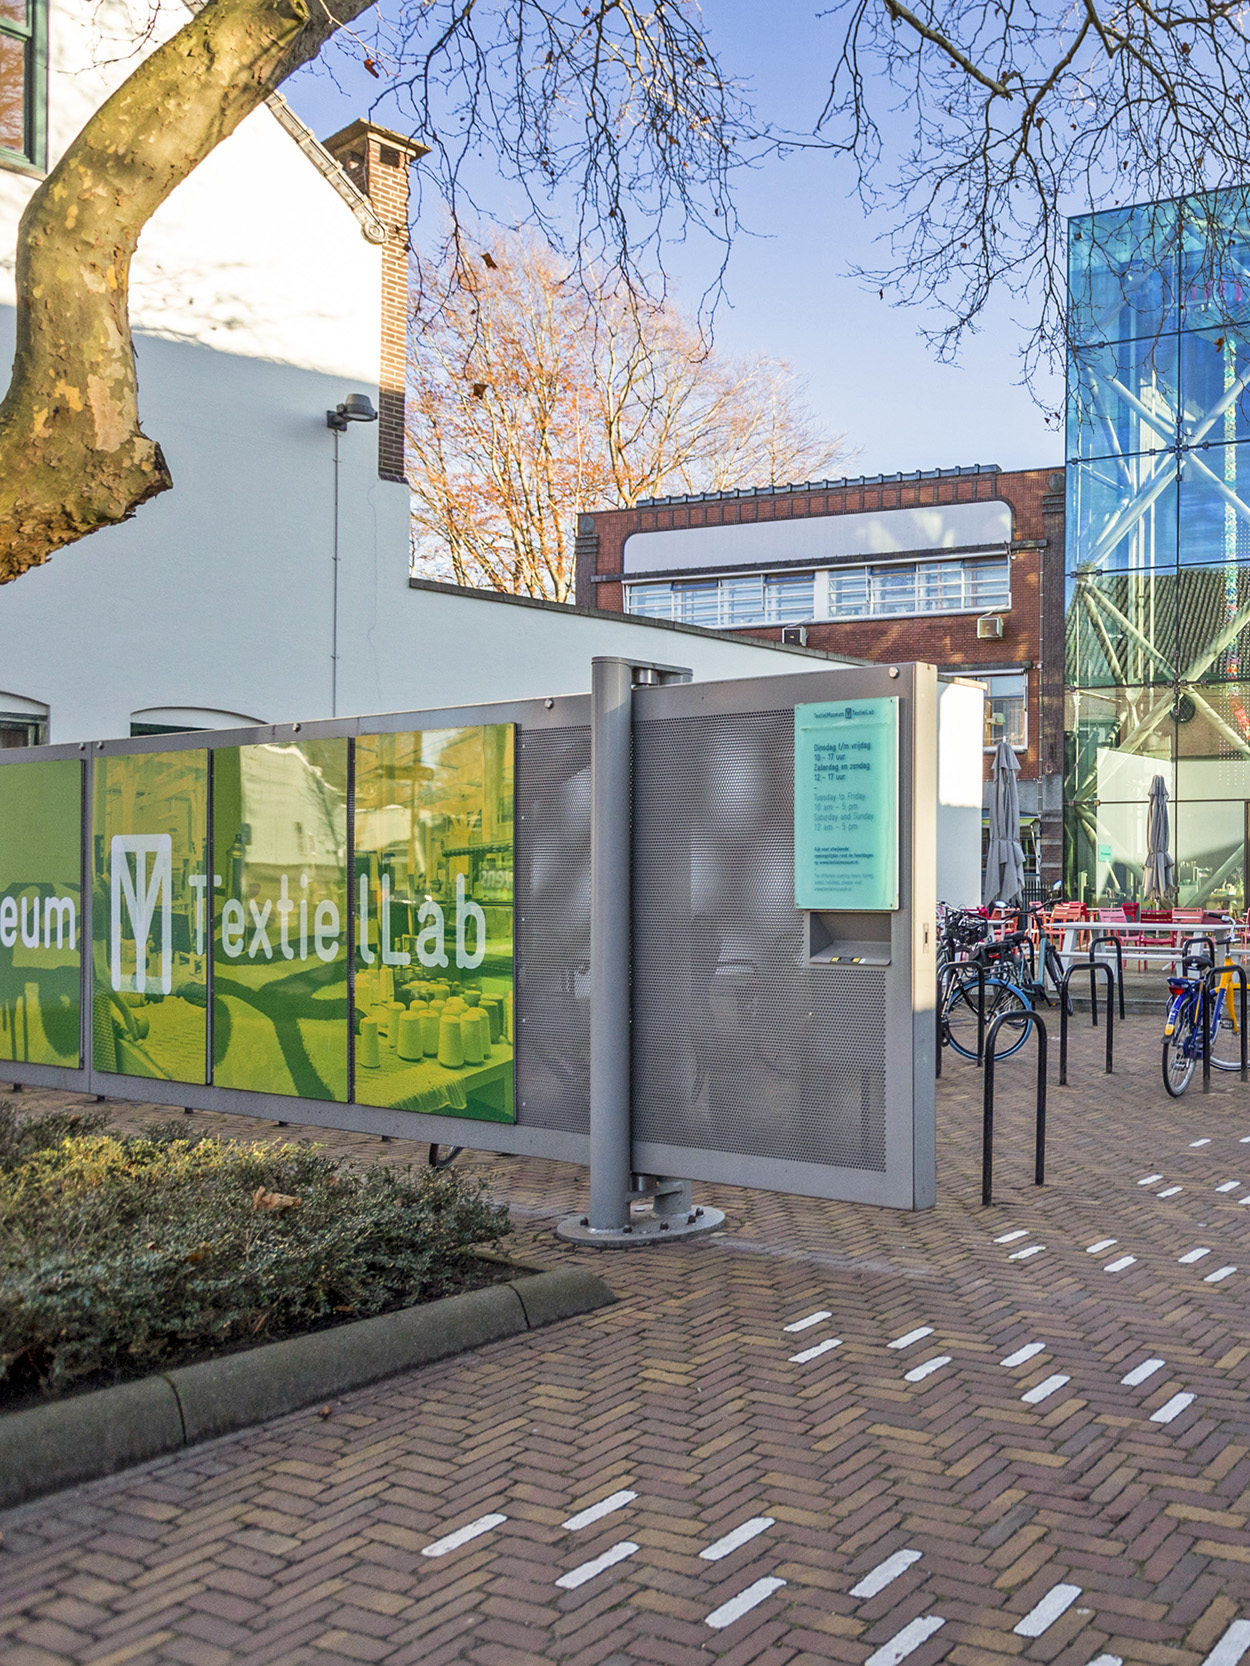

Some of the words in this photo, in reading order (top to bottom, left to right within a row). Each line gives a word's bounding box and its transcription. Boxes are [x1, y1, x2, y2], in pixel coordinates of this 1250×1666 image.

[814, 744, 836, 752] Dinsdag
[838, 742, 849, 750] t/m
[851, 742, 871, 750] vrijdag
[814, 763, 839, 772] Zaterdag
[850, 762, 870, 771] zondag
[814, 793, 836, 802] Tuesday
[848, 792, 866, 801] Friday
[848, 803, 859, 812] pm
[814, 813, 838, 822] Saturday
[840, 813, 851, 821] and
[853, 812, 874, 822] Sunday
[848, 823, 859, 832] pm
[0, 896, 76, 950] eum
[188, 874, 487, 970] TextielLab
